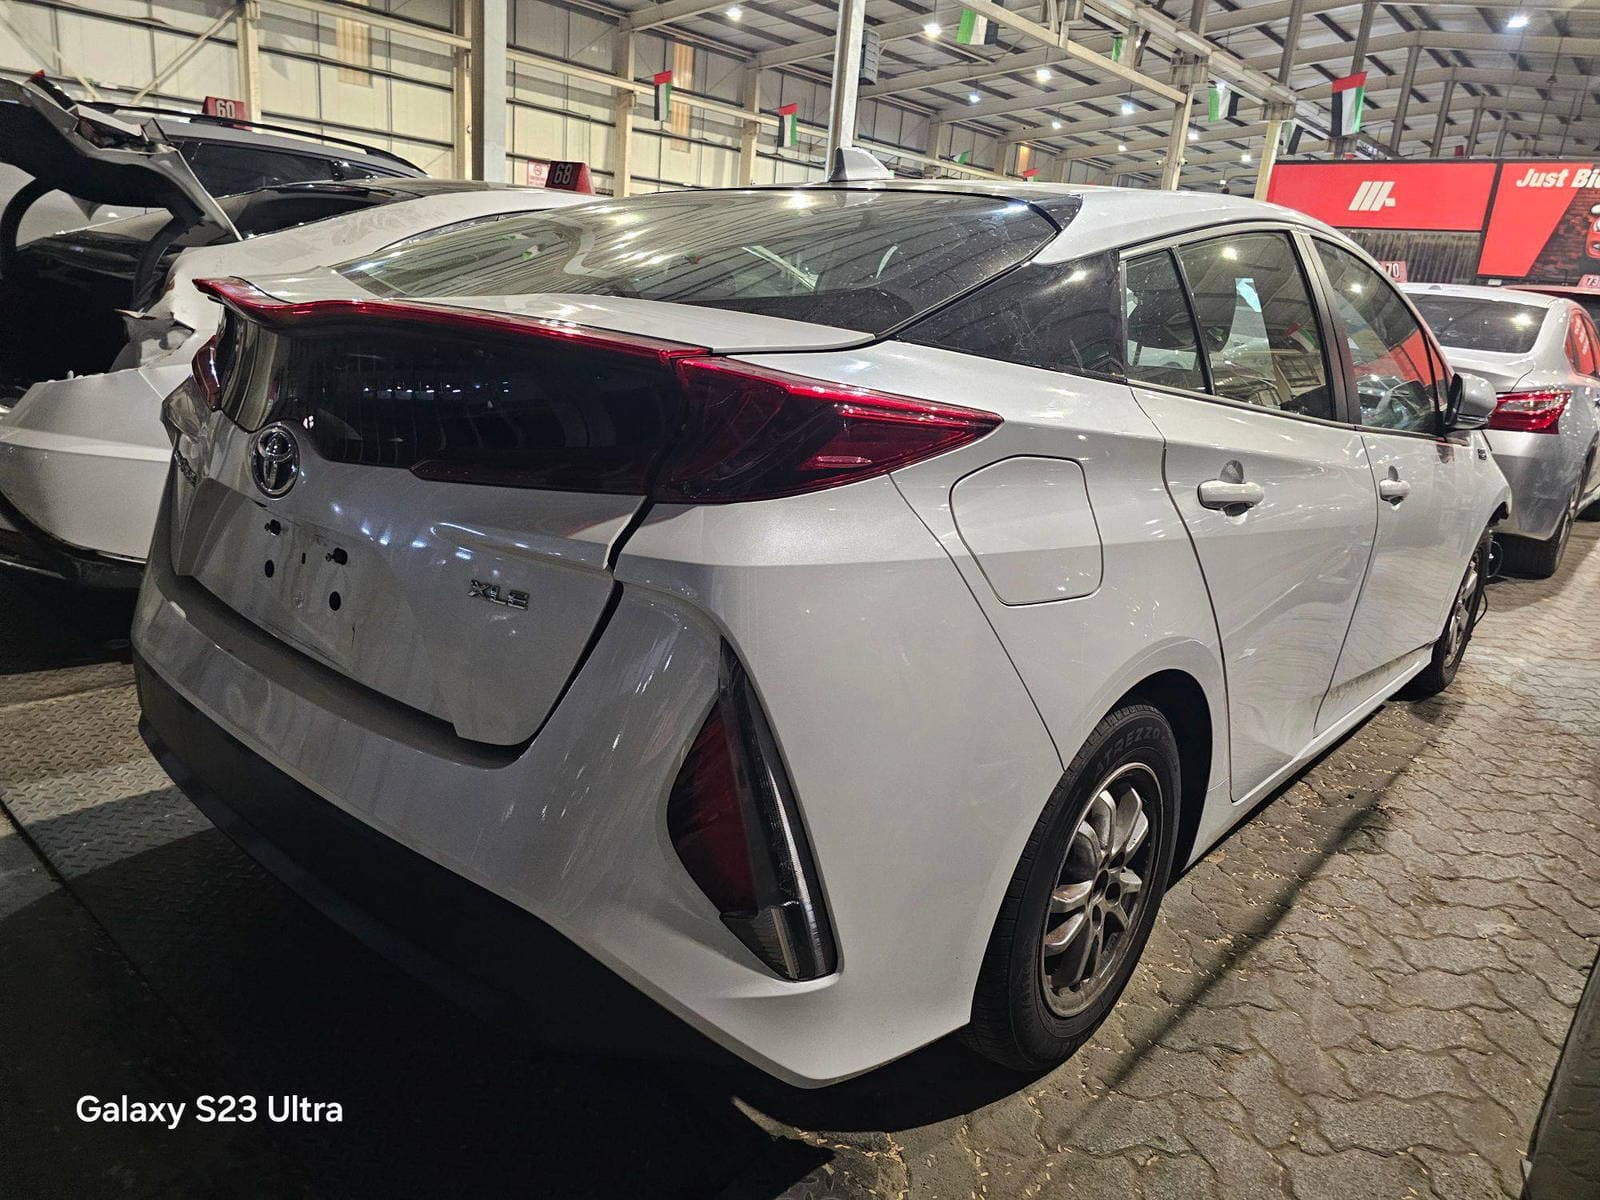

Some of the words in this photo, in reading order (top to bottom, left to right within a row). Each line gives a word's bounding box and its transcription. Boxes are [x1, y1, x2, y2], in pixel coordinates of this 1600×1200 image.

[215, 98, 236, 119] 60
[553, 163, 573, 185] 68
[1516, 168, 1569, 188] Just
[1385, 263, 1400, 278] 70
[467, 579, 529, 610] XLE
